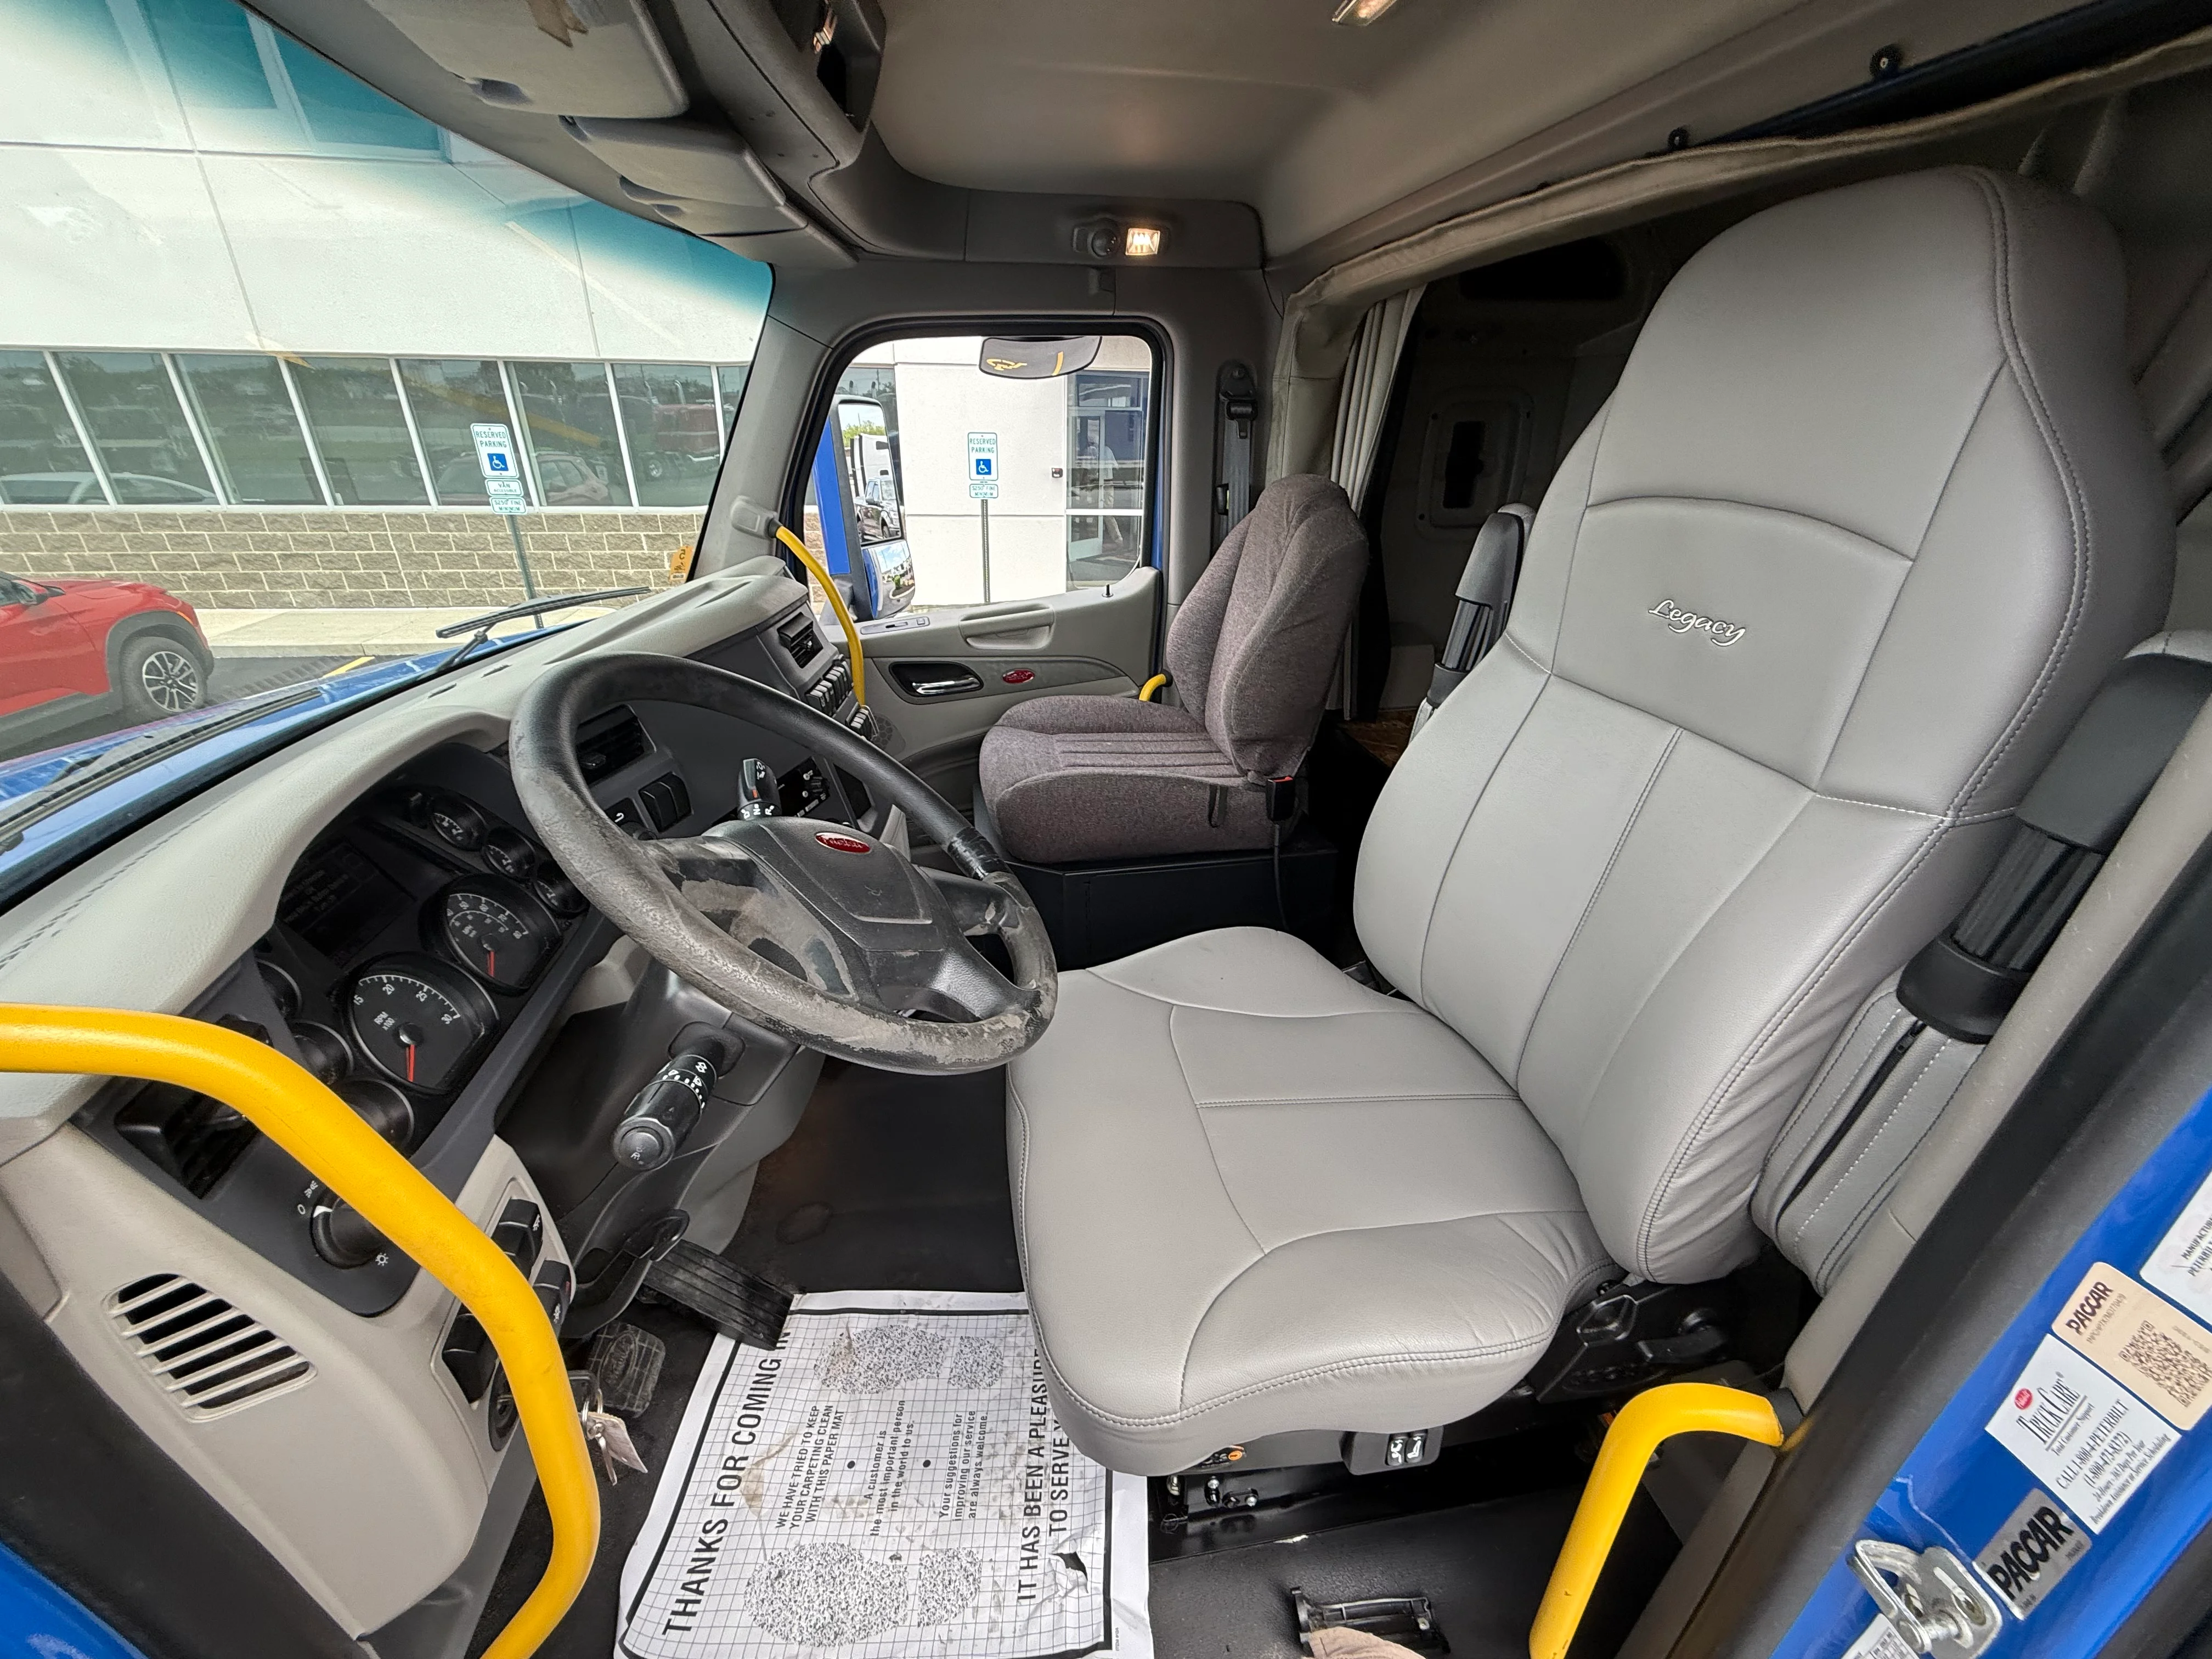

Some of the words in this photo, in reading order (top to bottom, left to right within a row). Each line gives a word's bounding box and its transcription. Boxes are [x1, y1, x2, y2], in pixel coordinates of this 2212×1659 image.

[1648, 599, 1746, 646] Legacy
[743, 811, 750, 819] D
[353, 994, 364, 1005] 15
[382, 984, 395, 995] 20
[415, 990, 427, 1002] 25
[374, 1011, 389, 1025] RPM
[441, 1014, 453, 1024] 30
[2065, 1282, 2114, 1336] PACCAR
[806, 1406, 820, 1428] KEEP
[893, 1400, 905, 1432] person
[906, 1420, 914, 1435] us.
[952, 1414, 962, 1427] for
[964, 1411, 975, 1445] service
[802, 1432, 812, 1443] TO
[901, 1438, 911, 1448] to
[975, 1412, 988, 1458] welcome.
[2056, 1465, 2080, 1489] CALL
[2071, 1398, 2129, 1470] 1-800-4-PETERBILT
[792, 1448, 808, 1477] TRIED
[868, 1442, 884, 1490] customer
[877, 1430, 887, 1439] is
[881, 1436, 899, 1485] important
[897, 1451, 909, 1479] world
[945, 1430, 961, 1489] suggestions
[962, 1448, 970, 1464] our
[1028, 1446, 1045, 1458] A
[789, 1500, 806, 1529] YOUR
[800, 1439, 824, 1496] CARPETING
[817, 1406, 833, 1435] CLEAN
[805, 1496, 822, 1523] WITH
[814, 1469, 829, 1492] THIS
[822, 1434, 839, 1465] PAPER
[831, 1410, 844, 1429] MAT
[969, 1461, 984, 1497] always
[1050, 1437, 1070, 1500] SERVE
[662, 1519, 729, 1635] THANKS
[710, 1455, 749, 1506] FOR
[731, 1358, 782, 1445] COMING
[782, 1482, 799, 1508] HAVE
[876, 1488, 888, 1514] most
[891, 1481, 902, 1498] the
[952, 1467, 970, 1521] improving
[1023, 1465, 1043, 1516] BEEN
[888, 1502, 899, 1511] in
[939, 1493, 951, 1517] Your
[968, 1501, 978, 1518] are
[776, 1512, 789, 1528] WE
[870, 1519, 882, 1536] the
[1049, 1510, 1068, 1536] TO
[1019, 1526, 1040, 1570] HAS
[1987, 1506, 2074, 1599] PACCAR
[1017, 1579, 1036, 1600] IT
